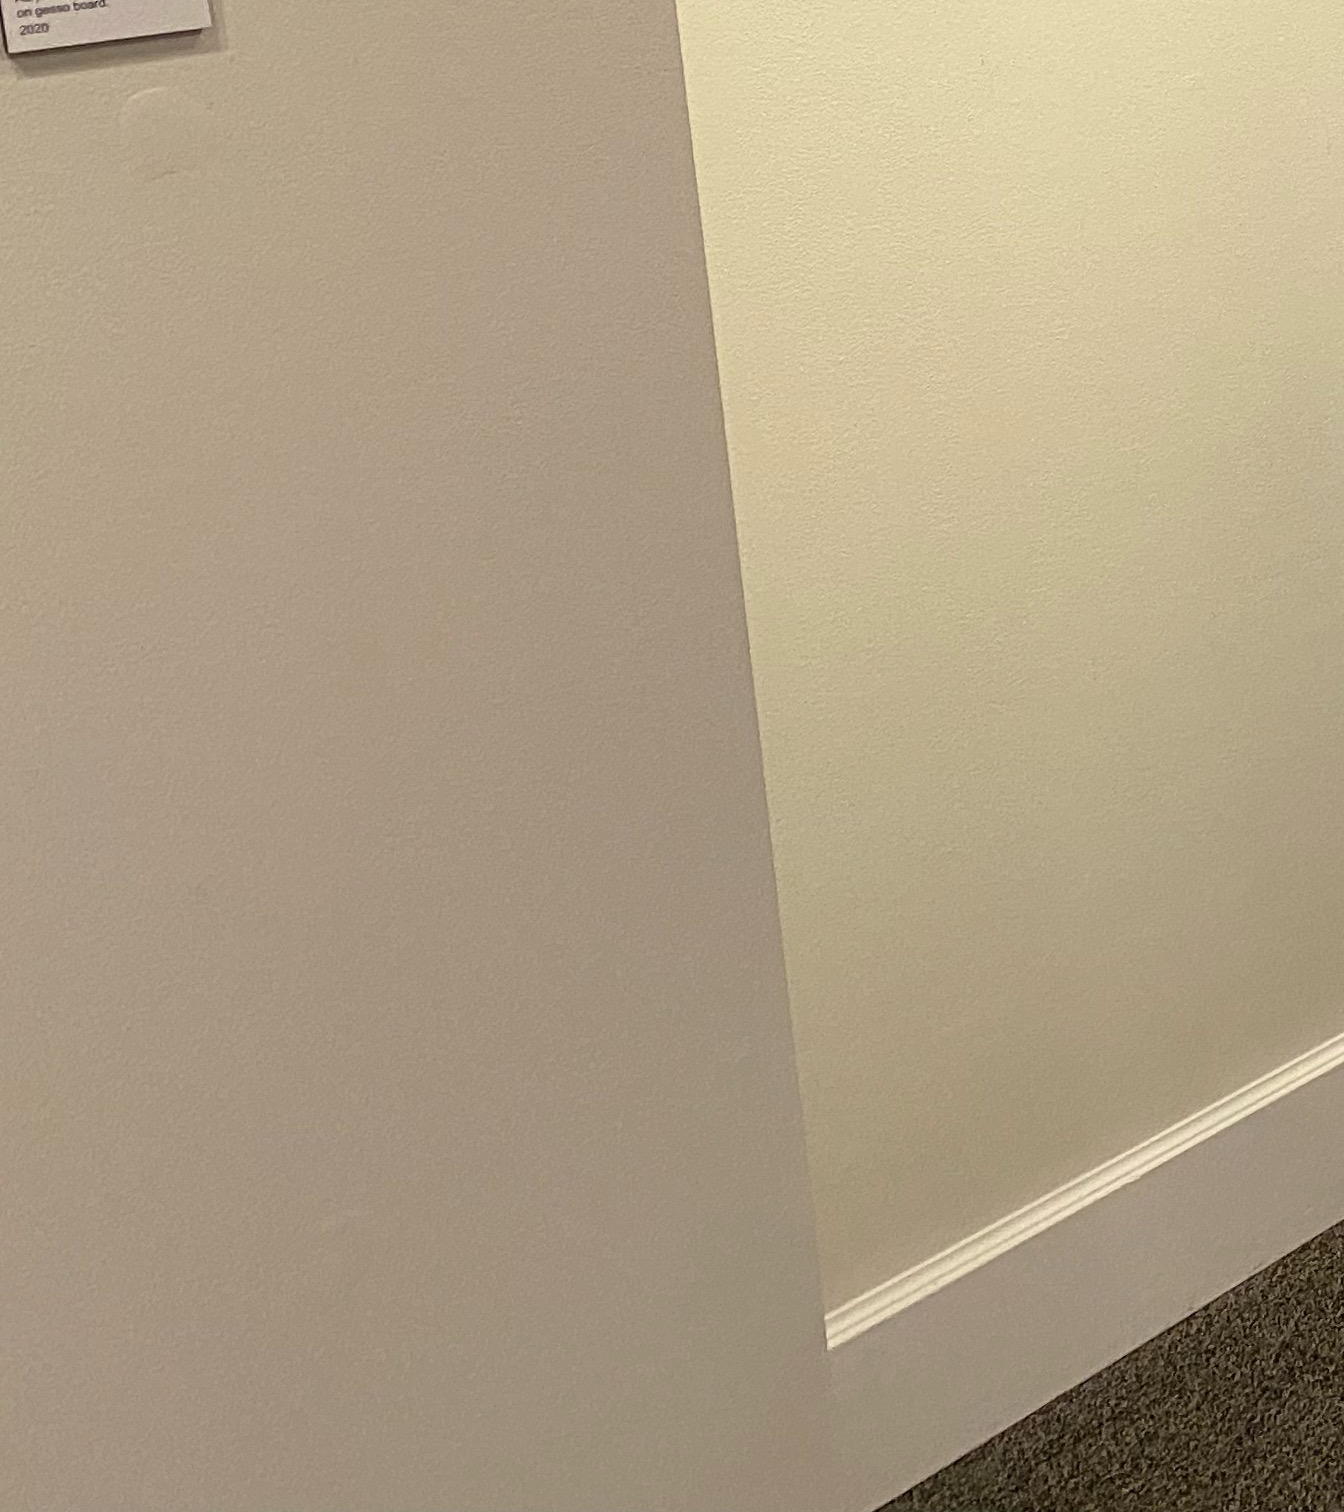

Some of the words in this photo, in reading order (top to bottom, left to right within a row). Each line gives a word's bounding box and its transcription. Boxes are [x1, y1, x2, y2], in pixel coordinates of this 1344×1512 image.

[16, 8, 33, 19] on
[34, 4, 71, 18] gesso
[19, 22, 50, 36] 2020
